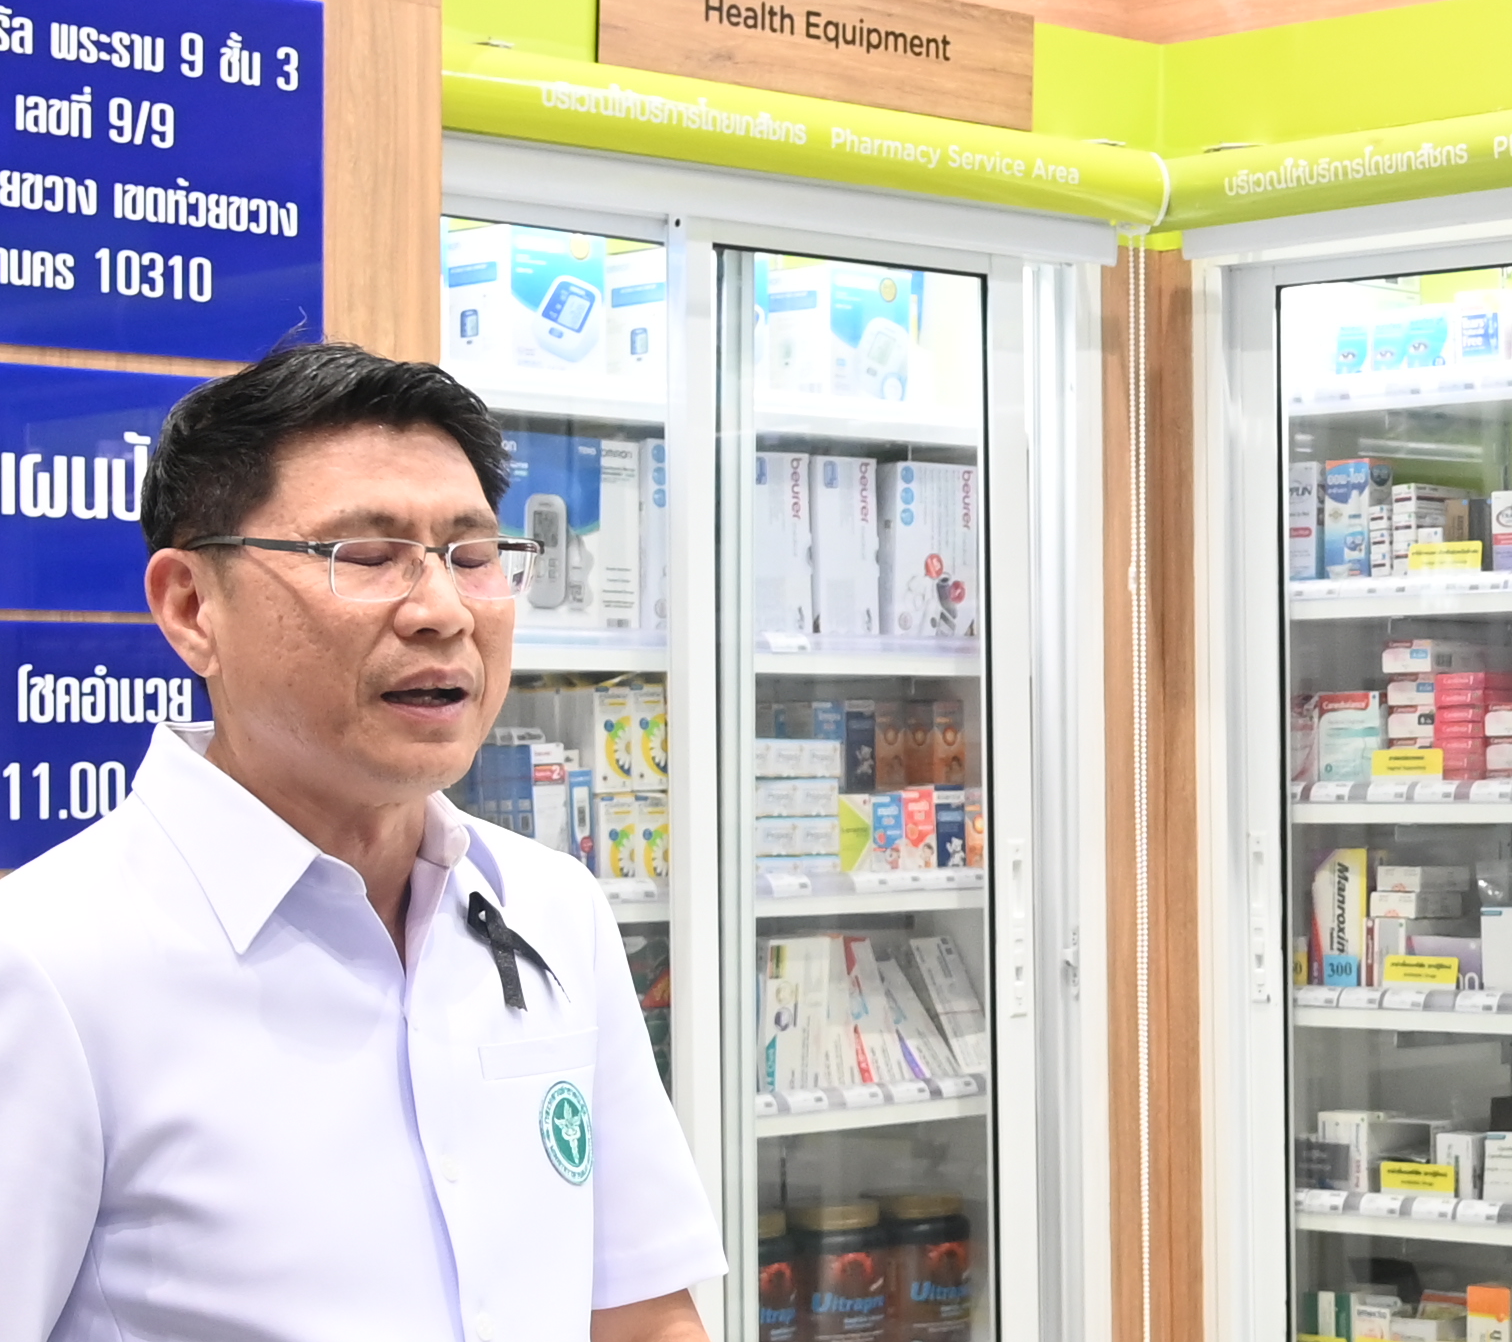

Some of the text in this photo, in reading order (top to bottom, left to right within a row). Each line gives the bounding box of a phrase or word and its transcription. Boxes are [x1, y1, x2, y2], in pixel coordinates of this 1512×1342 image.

[50, 21, 166, 78] พระราม
[180, 31, 205, 79] 9
[219, 31, 262, 88] ชั้น
[275, 46, 300, 93] 3
[805, 11, 952, 63] Equipment
[14, 84, 93, 141] เลขที่
[108, 97, 177, 150] 9/9
[830, 125, 942, 170] Pharmacy
[947, 143, 1027, 178] Service
[1032, 157, 1081, 186] Area
[113, 177, 299, 239] เขตห้วยขวาง
[94, 247, 214, 305] 10310
[788, 457, 803, 522] beurer
[17, 664, 194, 725] โชคอำนวย
[2, 761, 127, 822] 11.00
[1326, 960, 1354, 979] 300
